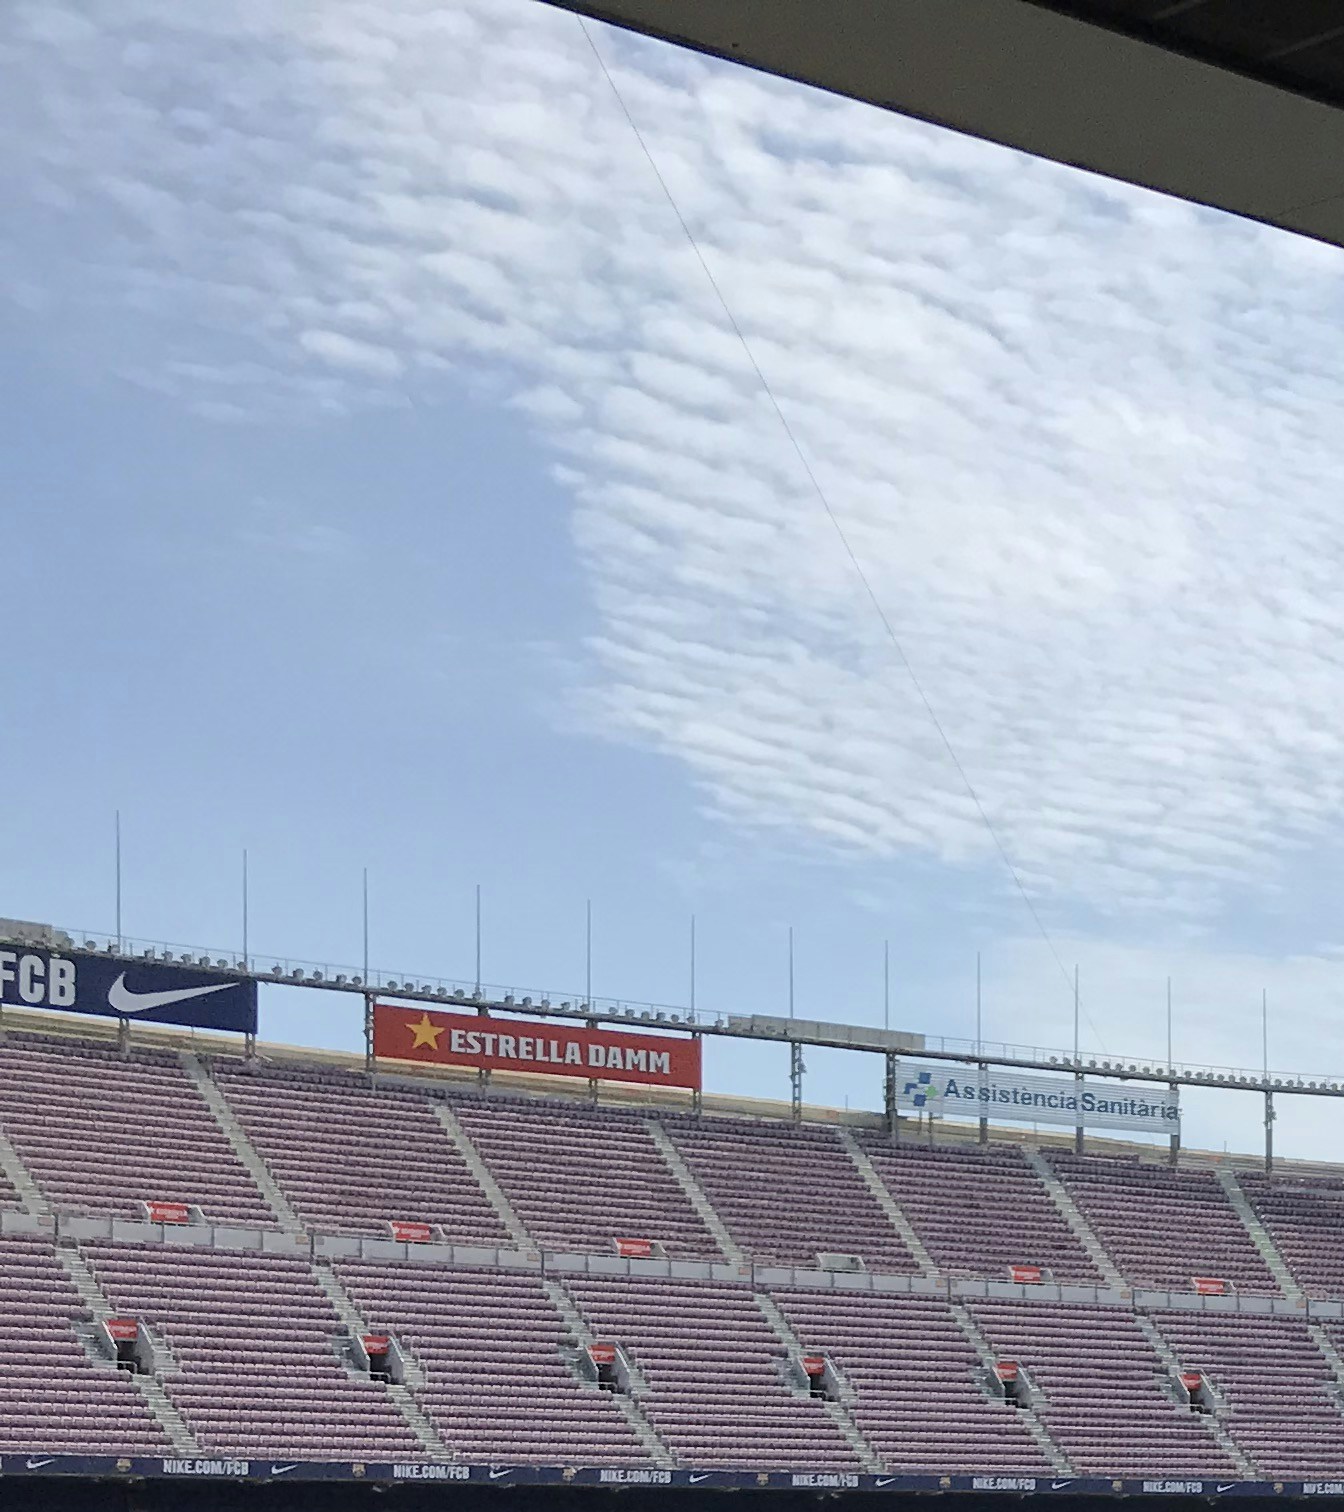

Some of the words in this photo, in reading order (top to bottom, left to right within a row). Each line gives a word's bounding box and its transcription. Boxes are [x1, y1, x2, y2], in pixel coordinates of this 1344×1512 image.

[450, 1029, 582, 1065] ESTRELLA
[588, 1044, 670, 1075] DAMM
[944, 1079, 1077, 1110] Assistència
[1080, 1092, 1179, 1120] Sanitària
[163, 1459, 249, 1477] NIKE.COM/FCB
[393, 1465, 470, 1481] NIKE.COM/FCB
[599, 1470, 671, 1485] NIKE.COM/FCB
[792, 1474, 859, 1487] NIKE.COM/FCB
[973, 1477, 1036, 1490] NIKE.COM/FCB
[1143, 1479, 1203, 1493] NIKE.COM/FCB
